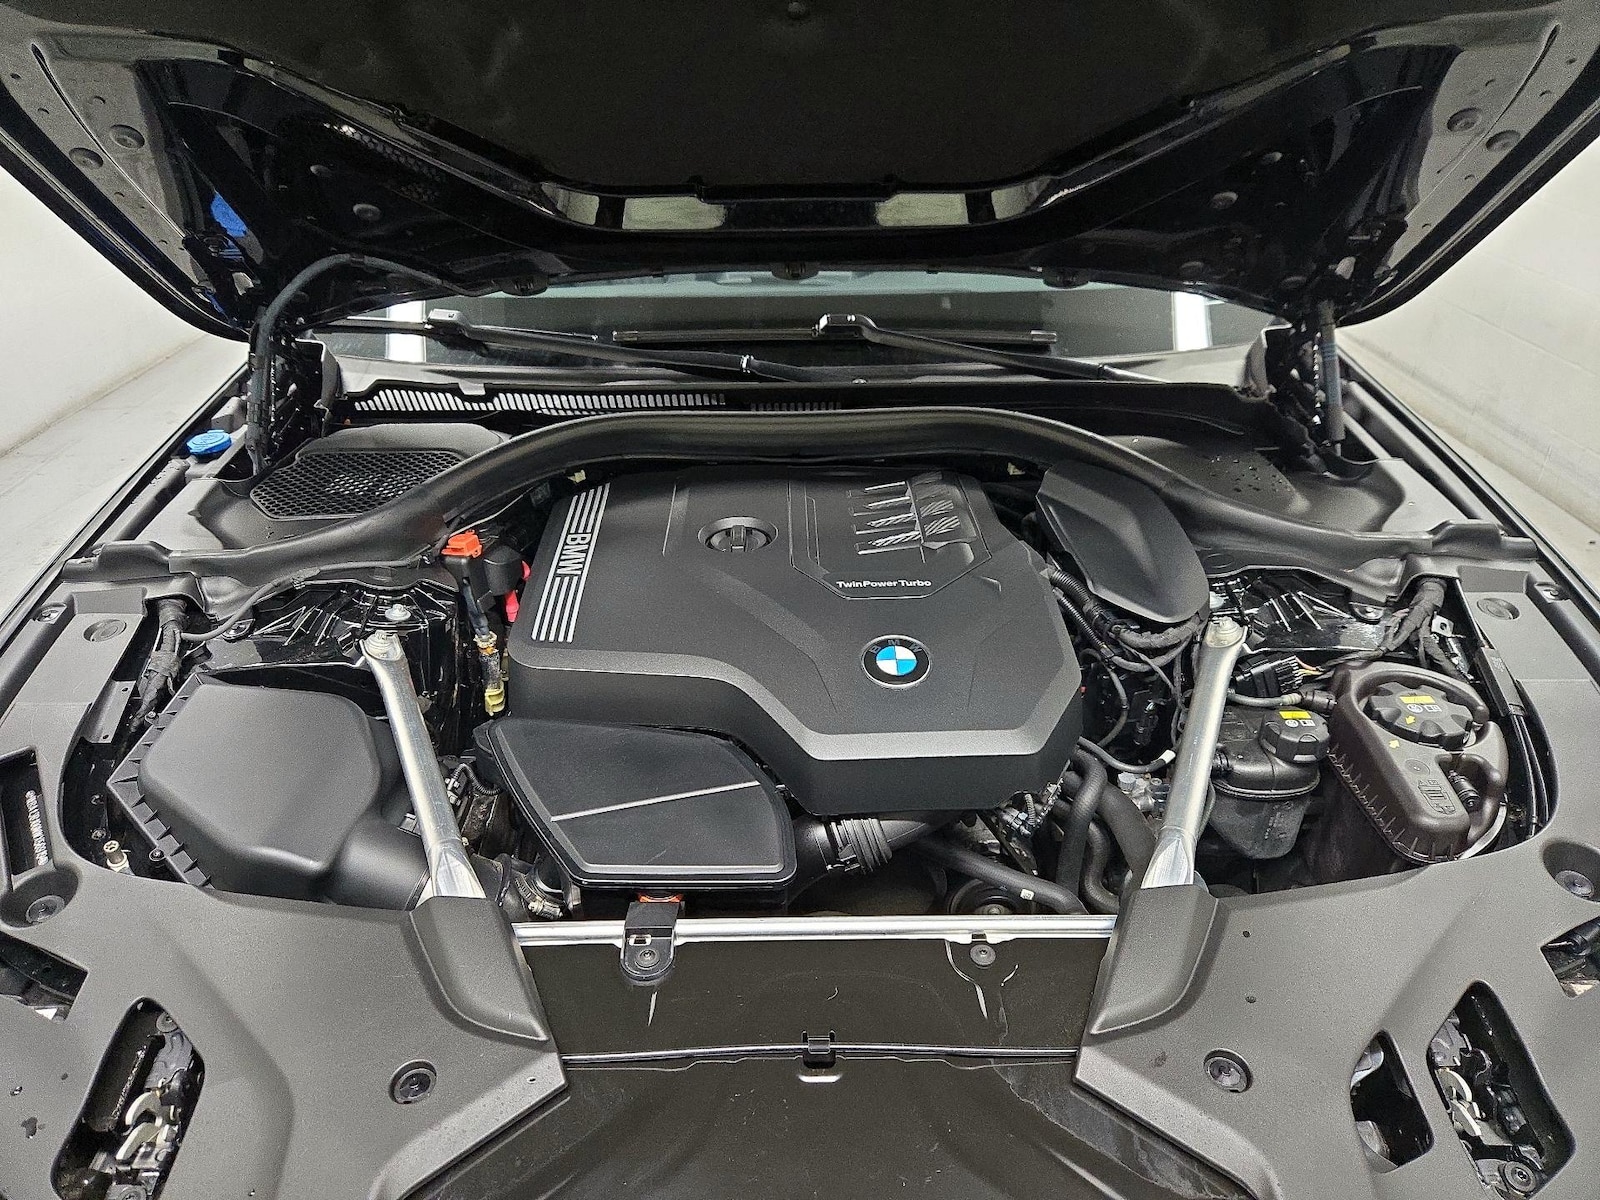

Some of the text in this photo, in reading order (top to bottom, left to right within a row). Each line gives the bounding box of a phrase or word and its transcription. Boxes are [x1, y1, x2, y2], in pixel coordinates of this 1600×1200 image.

[556, 533, 592, 575] BMW
[836, 579, 932, 588] TwinPower Turbo
[868, 639, 923, 654] BMW
